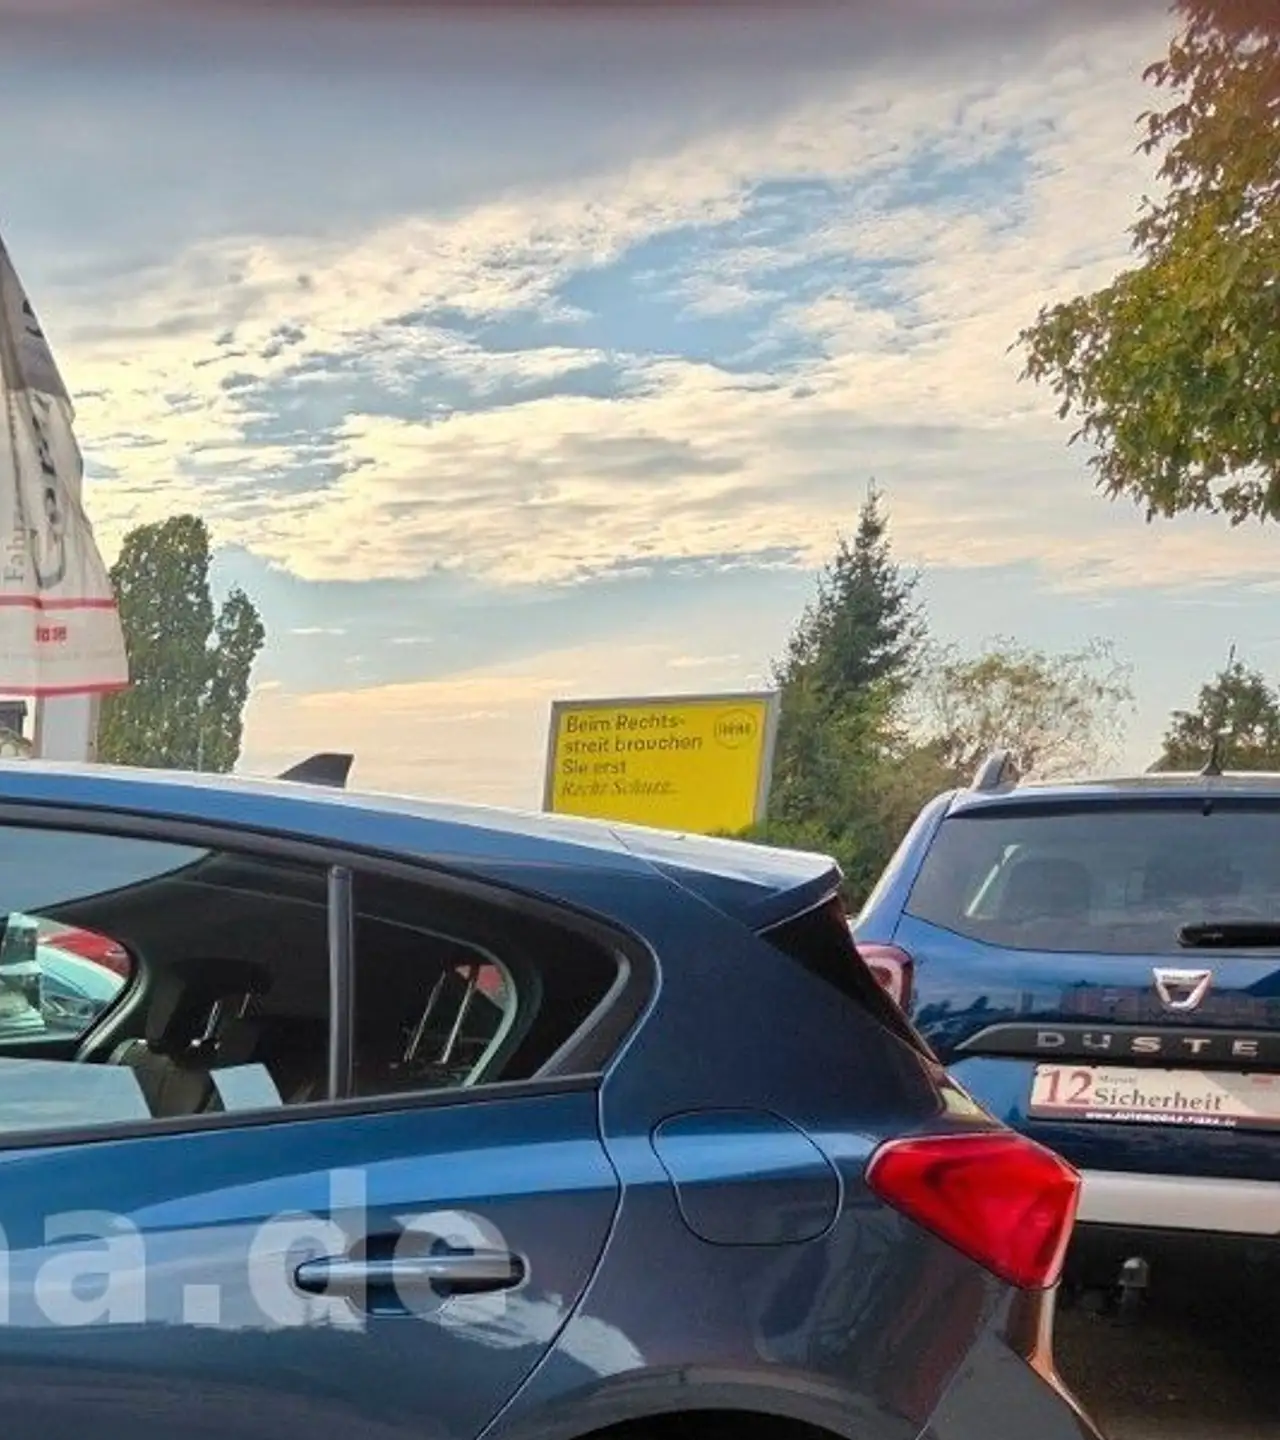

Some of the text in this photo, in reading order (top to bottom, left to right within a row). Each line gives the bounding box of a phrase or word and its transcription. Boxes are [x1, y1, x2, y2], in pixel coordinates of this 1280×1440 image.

[567, 716, 610, 733] Beim
[565, 737, 609, 754] streit
[1040, 1069, 1093, 1105] 12
[1094, 1088, 1223, 1112] Sicherheit
